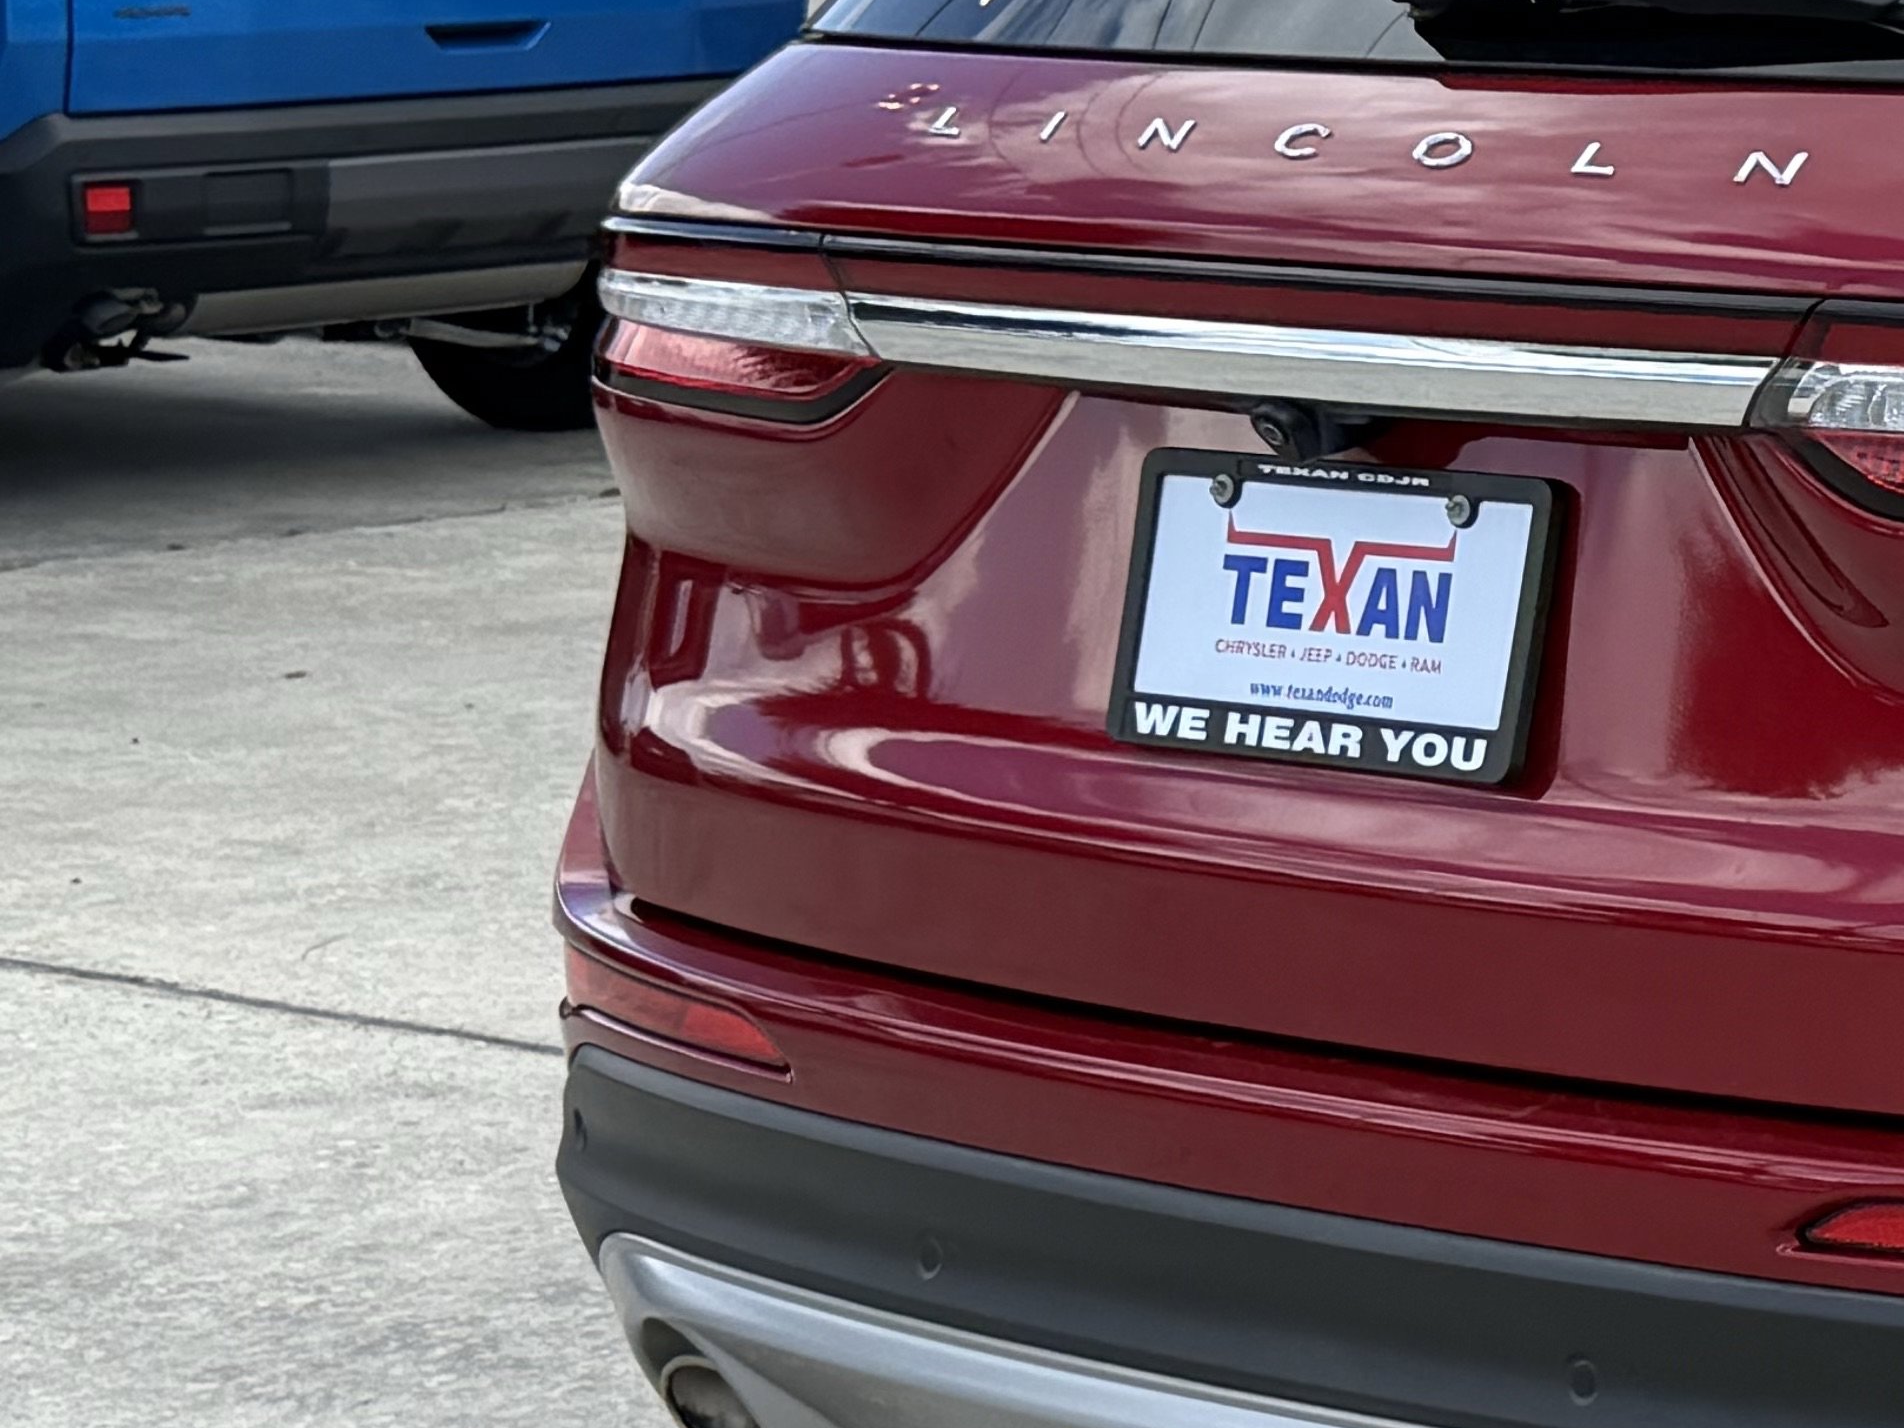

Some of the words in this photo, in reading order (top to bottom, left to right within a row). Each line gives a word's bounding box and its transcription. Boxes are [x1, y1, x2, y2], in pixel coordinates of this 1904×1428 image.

[930, 104, 1810, 187] LINCOLN
[1257, 463, 1349, 481] TEXAN
[1357, 472, 1430, 487] CDJR
[1222, 538, 1453, 643] TEXAN
[1215, 638, 1287, 659] CHRYSLER
[1299, 647, 1333, 663] JEEP
[1346, 651, 1398, 670] DODGE
[1410, 657, 1442, 675] RAM
[1250, 682, 1393, 710] www.texandodge.com
[1134, 702, 1209, 740] WE
[1223, 711, 1363, 759] HEAR
[1380, 731, 1488, 772] YOU
